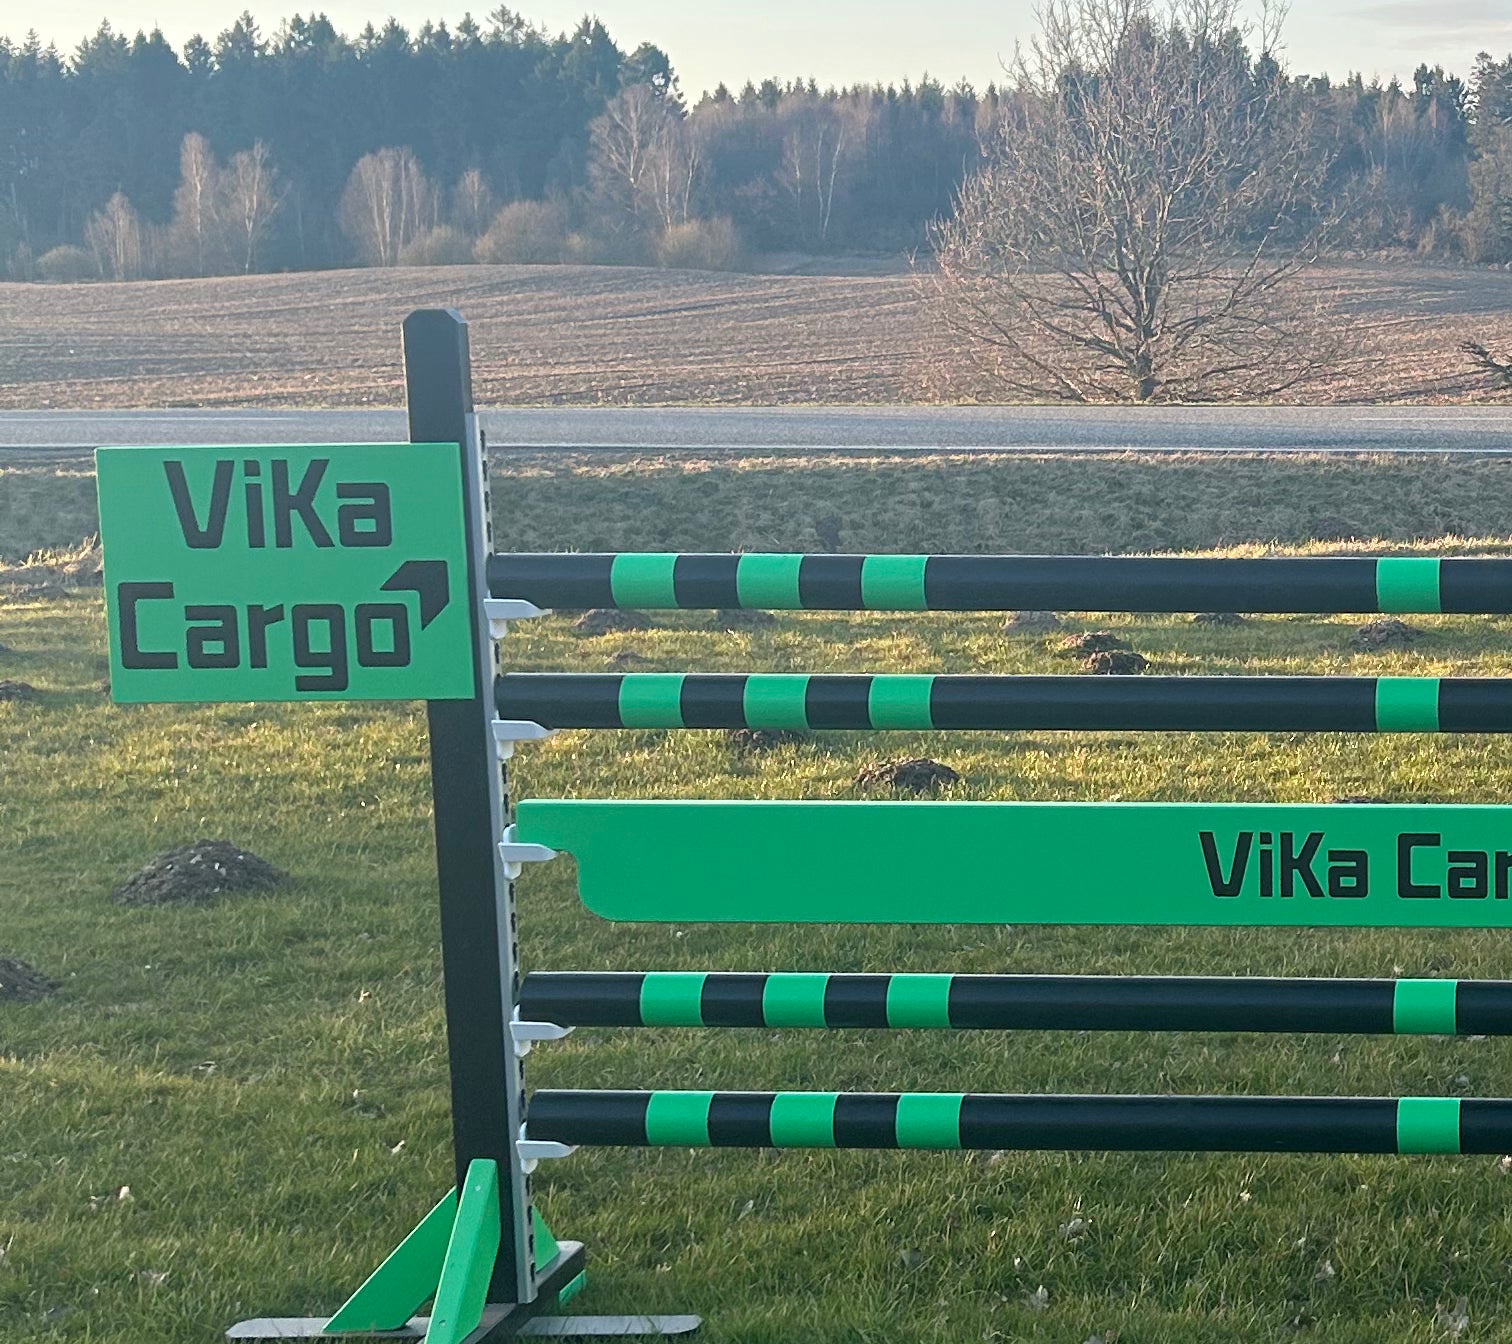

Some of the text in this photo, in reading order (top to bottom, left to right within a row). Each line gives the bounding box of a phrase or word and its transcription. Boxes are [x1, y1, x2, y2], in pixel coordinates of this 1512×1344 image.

[163, 459, 393, 549] ViKa
[117, 581, 411, 692] Cargo
[1198, 831, 1369, 899] ViKa
